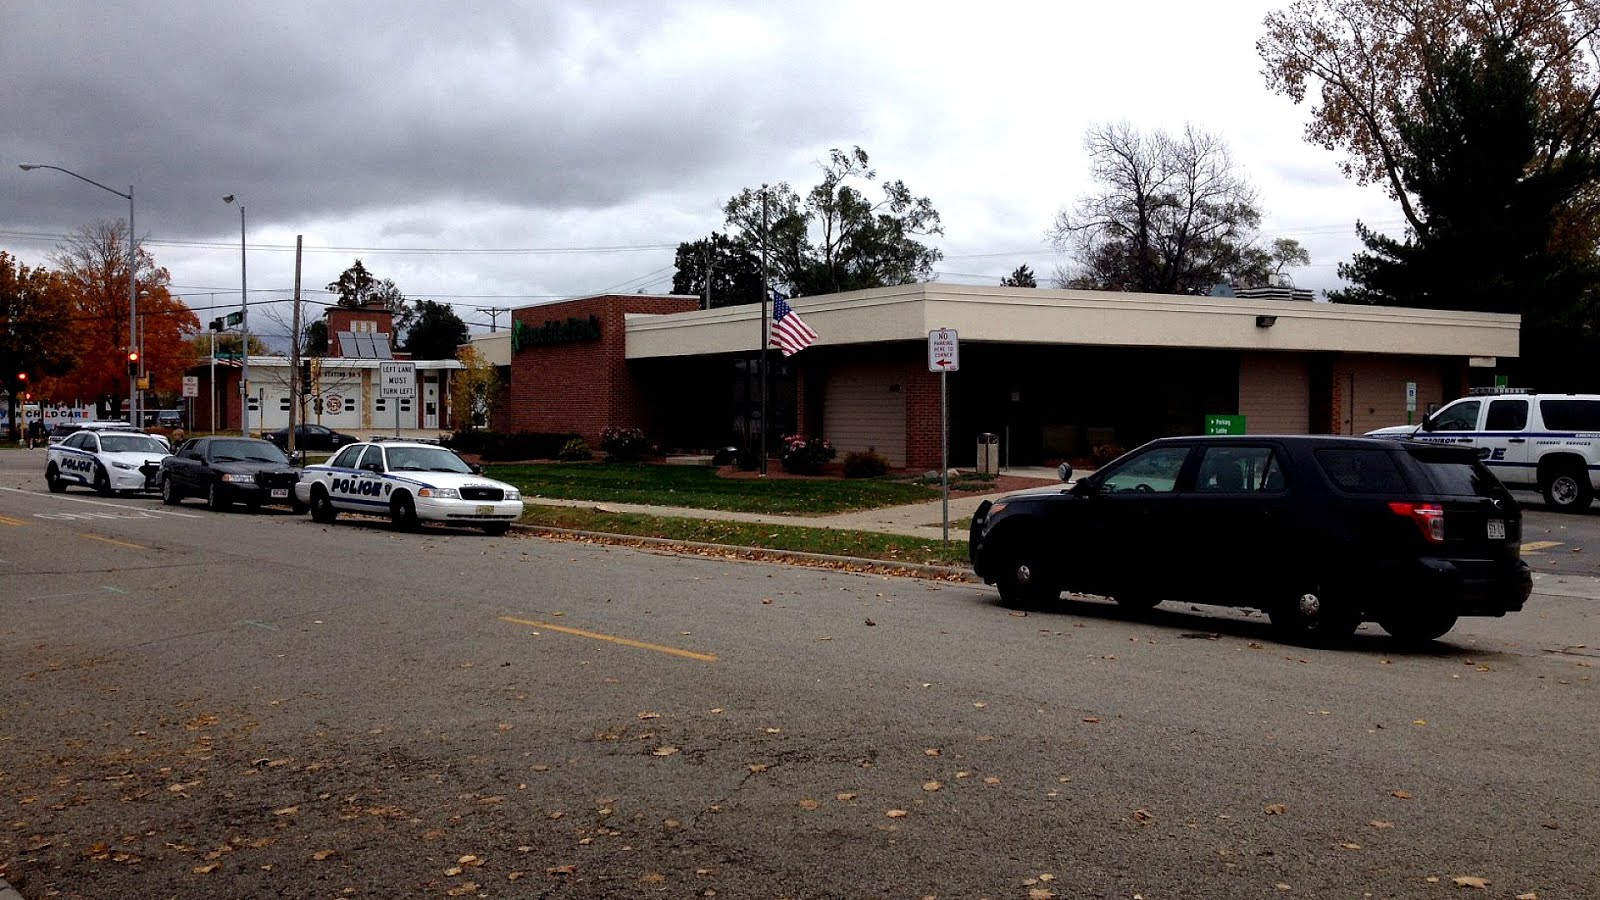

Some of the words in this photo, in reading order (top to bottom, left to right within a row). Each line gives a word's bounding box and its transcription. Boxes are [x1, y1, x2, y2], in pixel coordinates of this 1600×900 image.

[25, 410, 58, 418] CHLD
[60, 410, 89, 418] CARE
[61, 457, 92, 473] POLICE
[331, 478, 382, 497] POLICE
